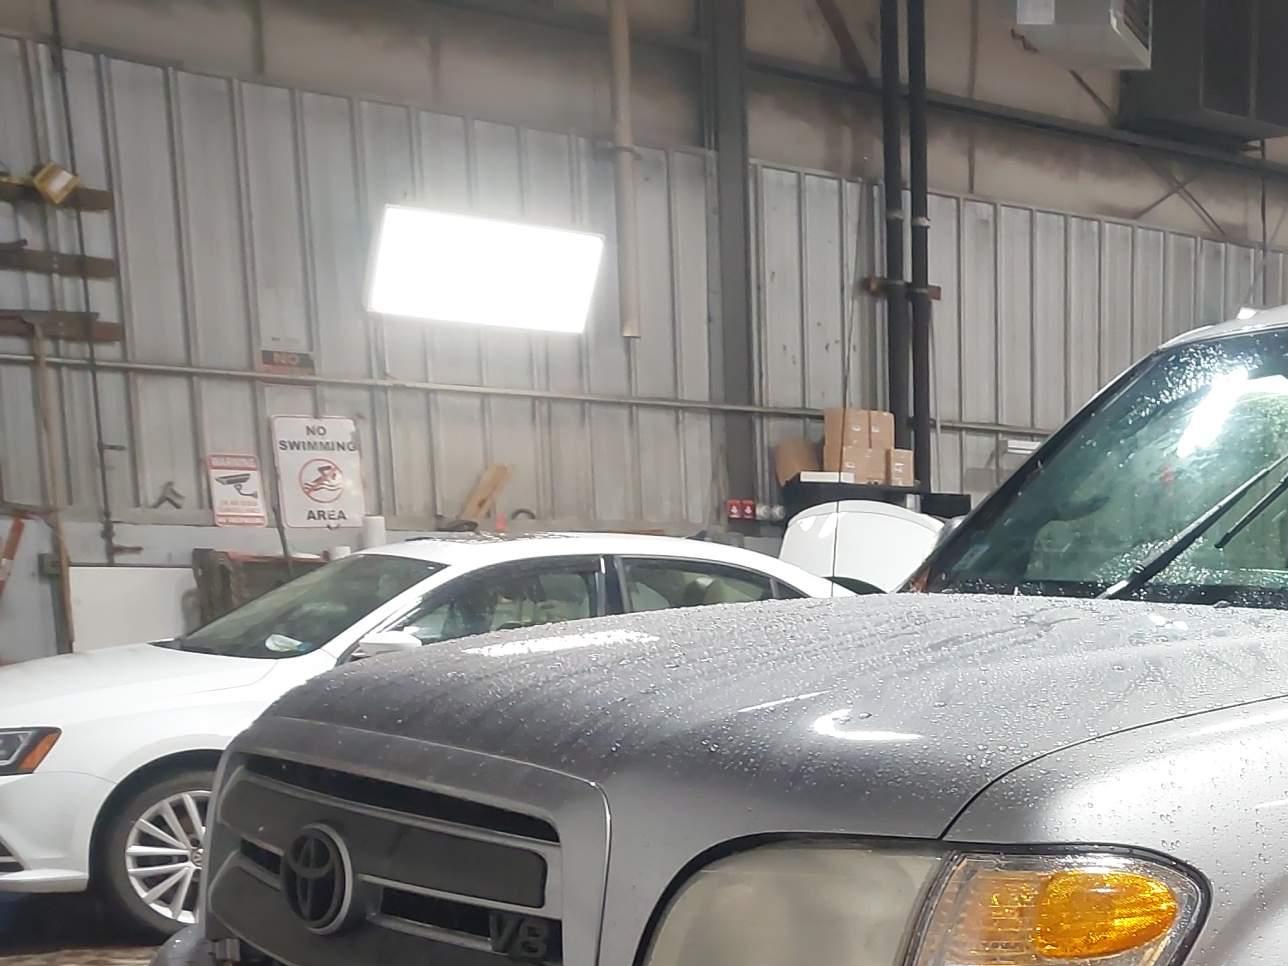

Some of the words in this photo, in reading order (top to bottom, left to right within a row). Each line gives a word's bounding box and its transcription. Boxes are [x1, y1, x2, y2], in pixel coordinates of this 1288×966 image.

[305, 425, 327, 436] NO
[279, 440, 357, 452] SWIMMING
[306, 509, 348, 521] AREA
[488, 913, 548, 960] V8
